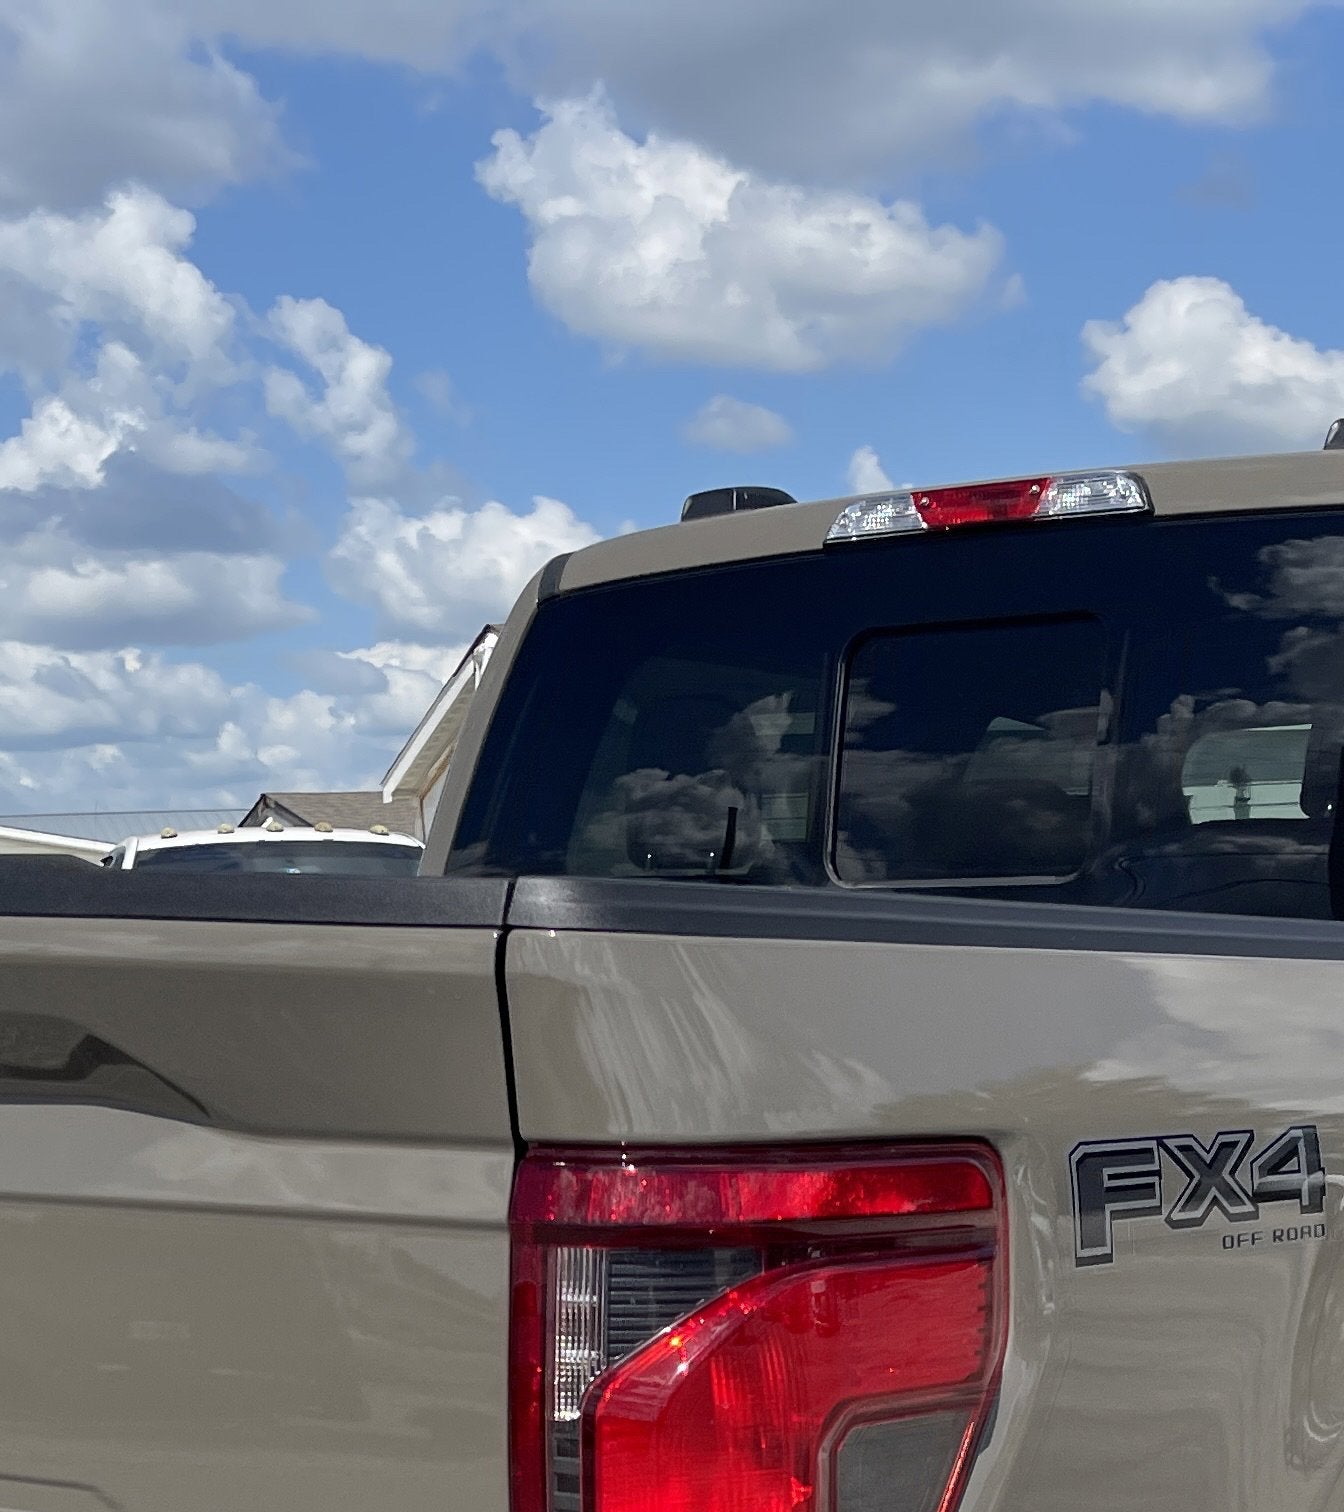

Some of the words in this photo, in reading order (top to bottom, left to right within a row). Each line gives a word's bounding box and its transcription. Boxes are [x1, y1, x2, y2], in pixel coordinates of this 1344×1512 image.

[1069, 1125, 1326, 1267] FX4
[1222, 1231, 1264, 1249] OFF
[1272, 1223, 1325, 1243] ROAD
